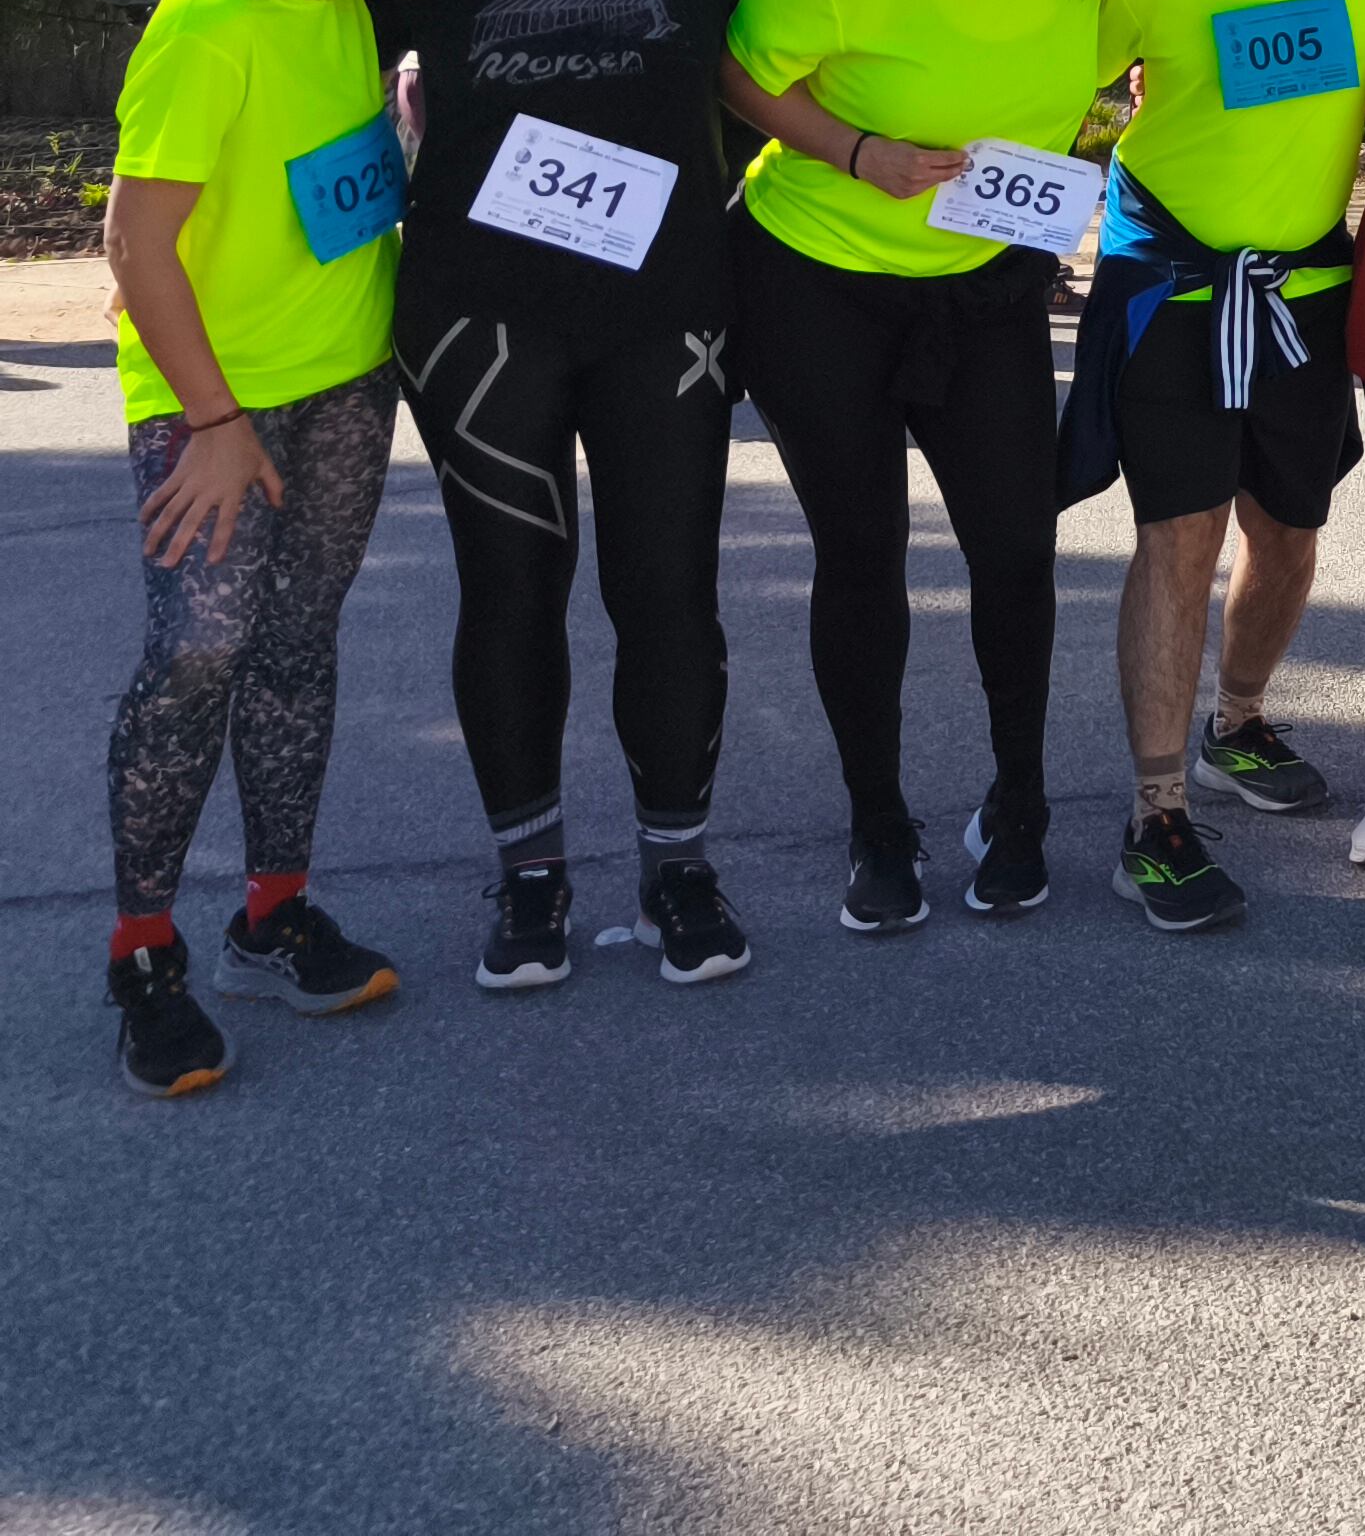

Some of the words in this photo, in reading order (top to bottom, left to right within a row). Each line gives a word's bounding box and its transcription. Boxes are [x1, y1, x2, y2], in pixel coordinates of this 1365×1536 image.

[1248, 27, 1323, 71] 005
[529, 158, 627, 218] 341
[974, 165, 1066, 216] 365
